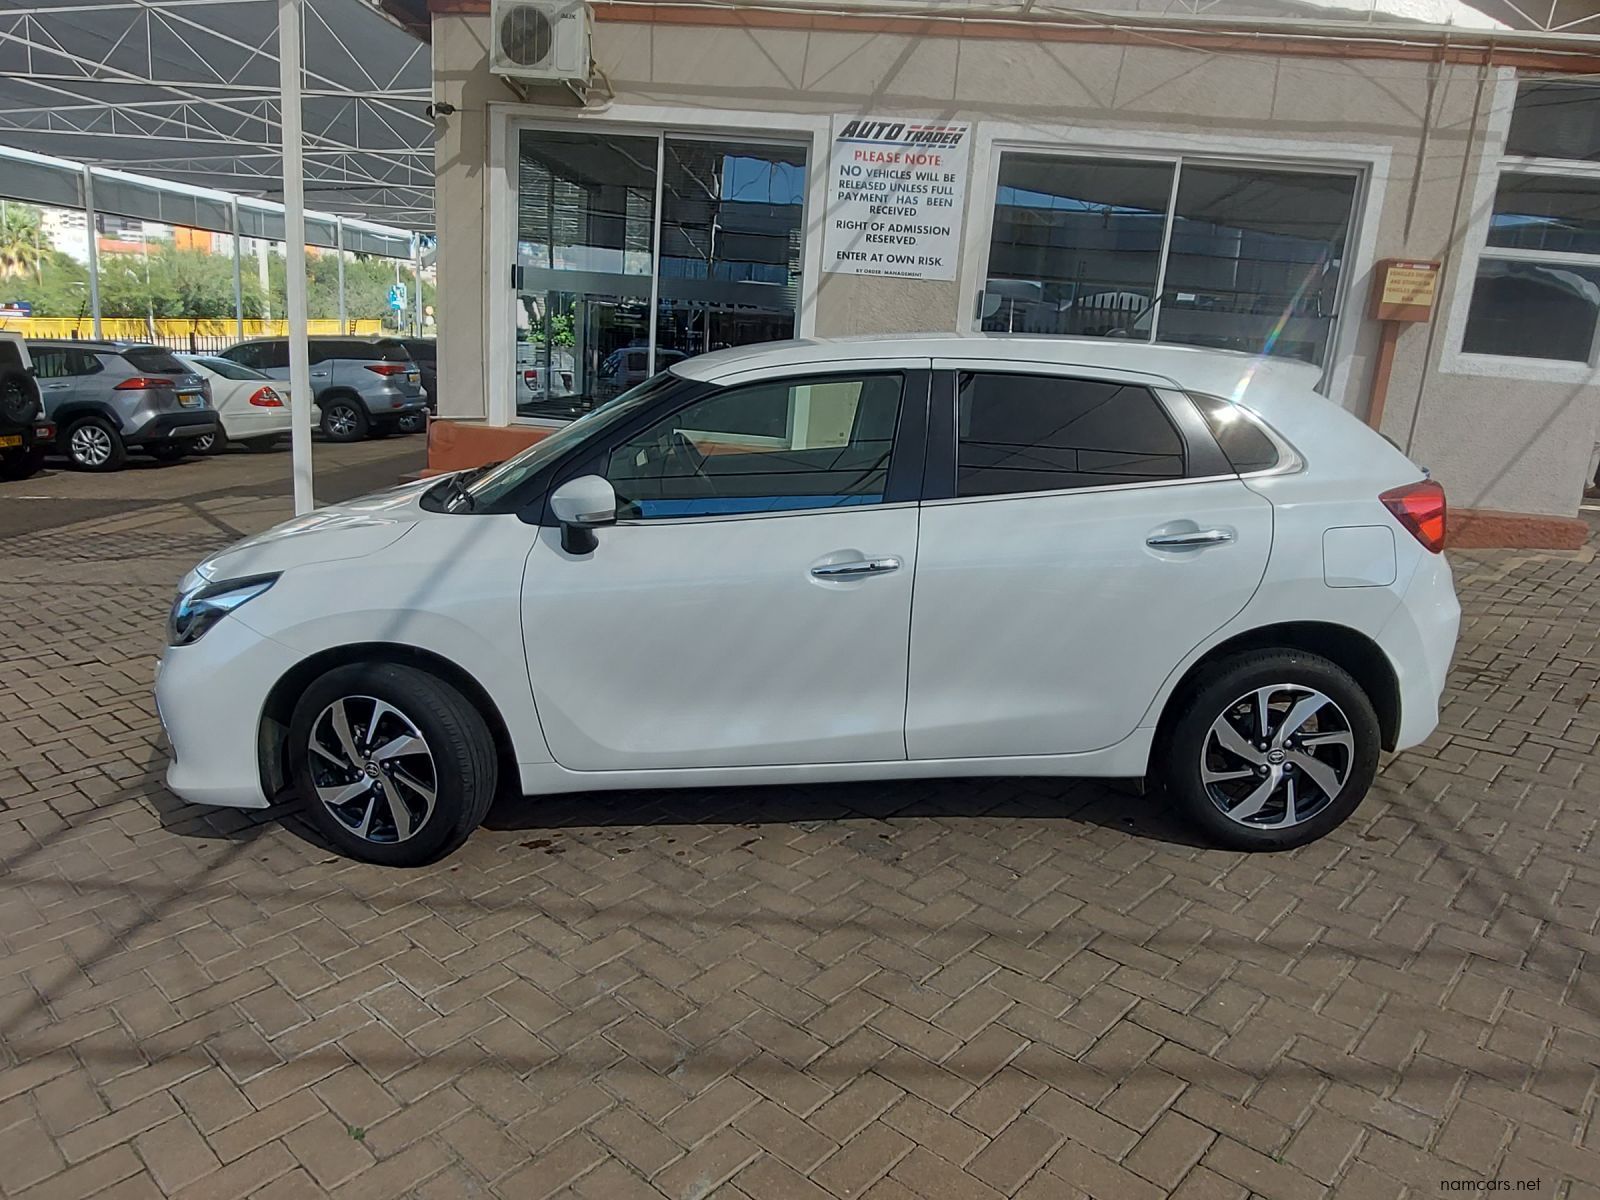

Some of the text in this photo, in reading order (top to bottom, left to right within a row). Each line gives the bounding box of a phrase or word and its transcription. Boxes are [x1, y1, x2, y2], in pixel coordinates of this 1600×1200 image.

[839, 120, 964, 145] AUTO TRADER
[854, 150, 901, 164] PLEASE
[840, 165, 956, 183] NO VEHICLES WILL BE
[839, 180, 954, 195] RELEASED UNLESS FULL
[838, 192, 953, 207] PAYMENT HAS BEEN
[836, 220, 951, 236] RIGHT OF ADMISSION
[836, 250, 867, 261] ENTER
[870, 253, 883, 262] AT
[886, 254, 915, 265] OWN
